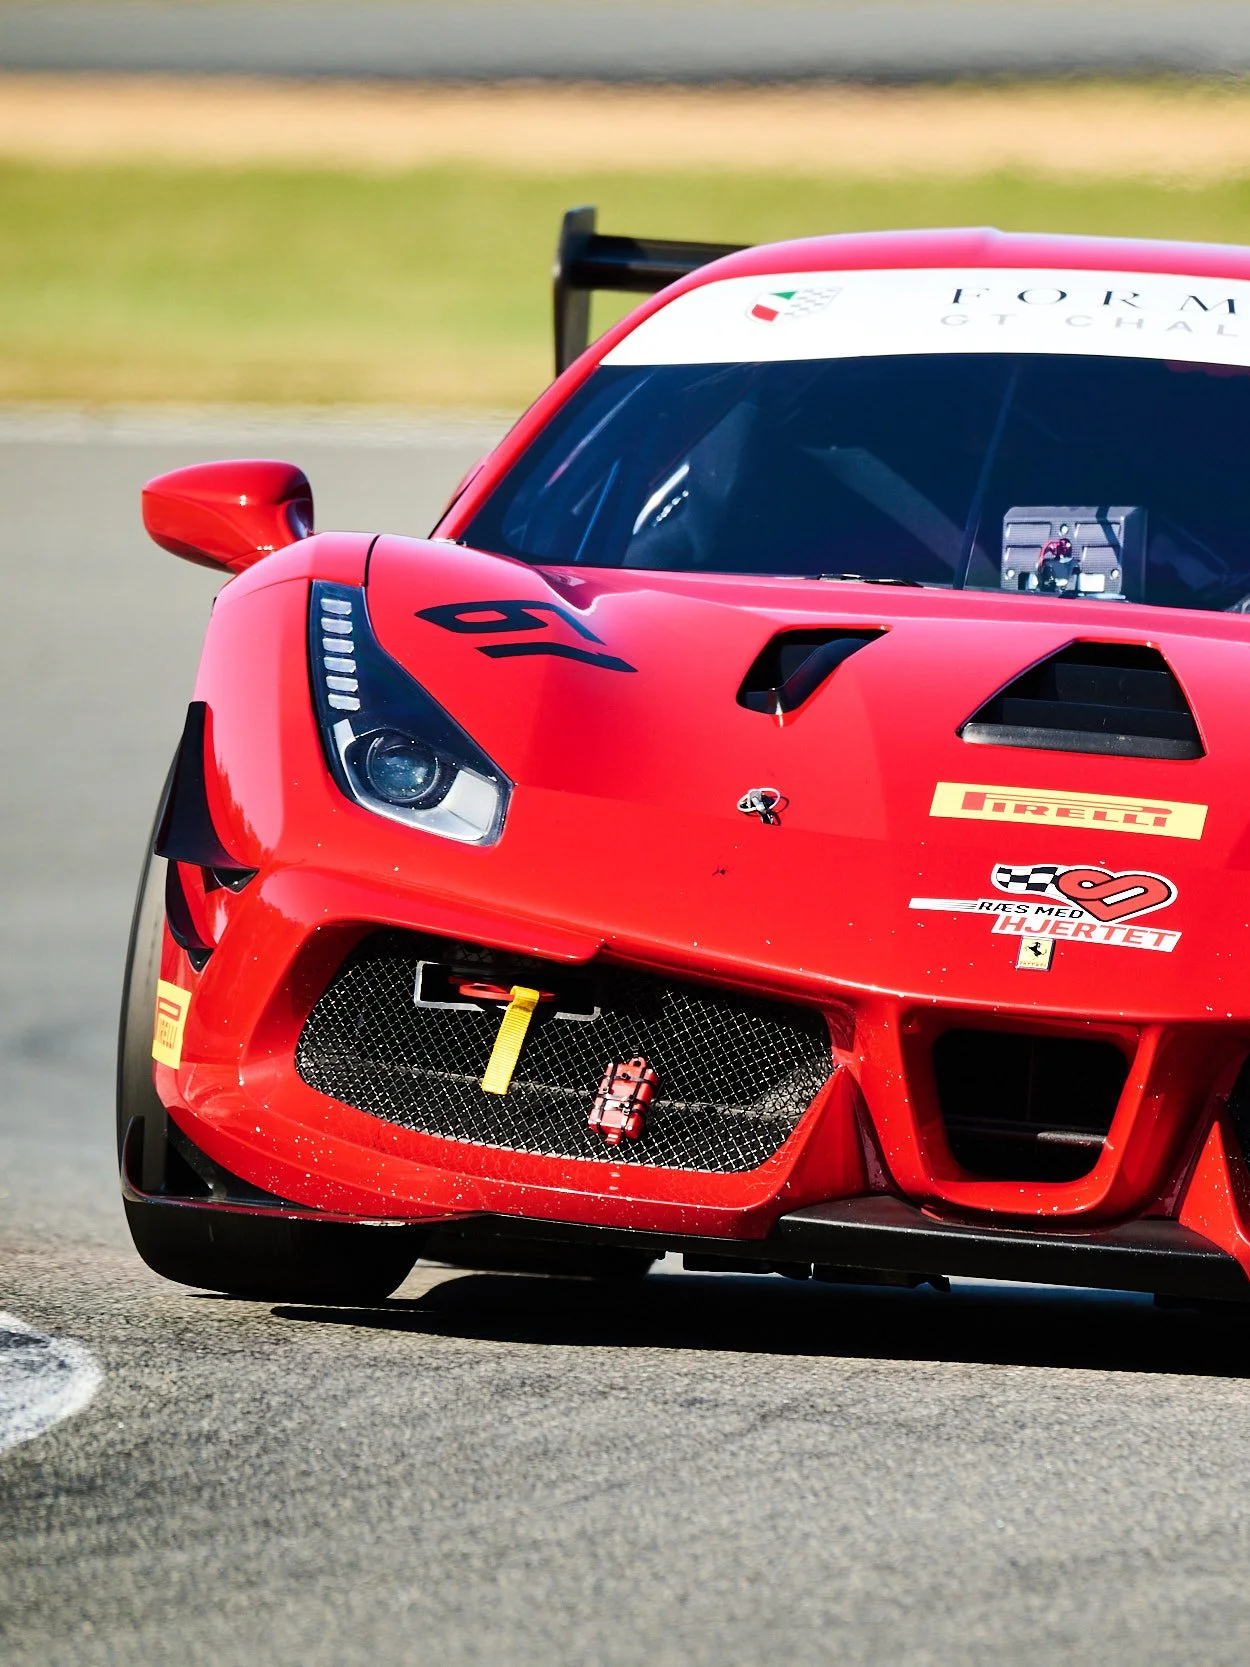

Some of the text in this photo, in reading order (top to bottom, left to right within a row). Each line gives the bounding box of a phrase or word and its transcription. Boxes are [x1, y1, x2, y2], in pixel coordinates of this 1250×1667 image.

[939, 312, 1018, 327] GT
[961, 791, 1173, 828] PIRELLI
[978, 901, 1085, 919] RÆS MED
[999, 915, 1177, 948] HJERTET
